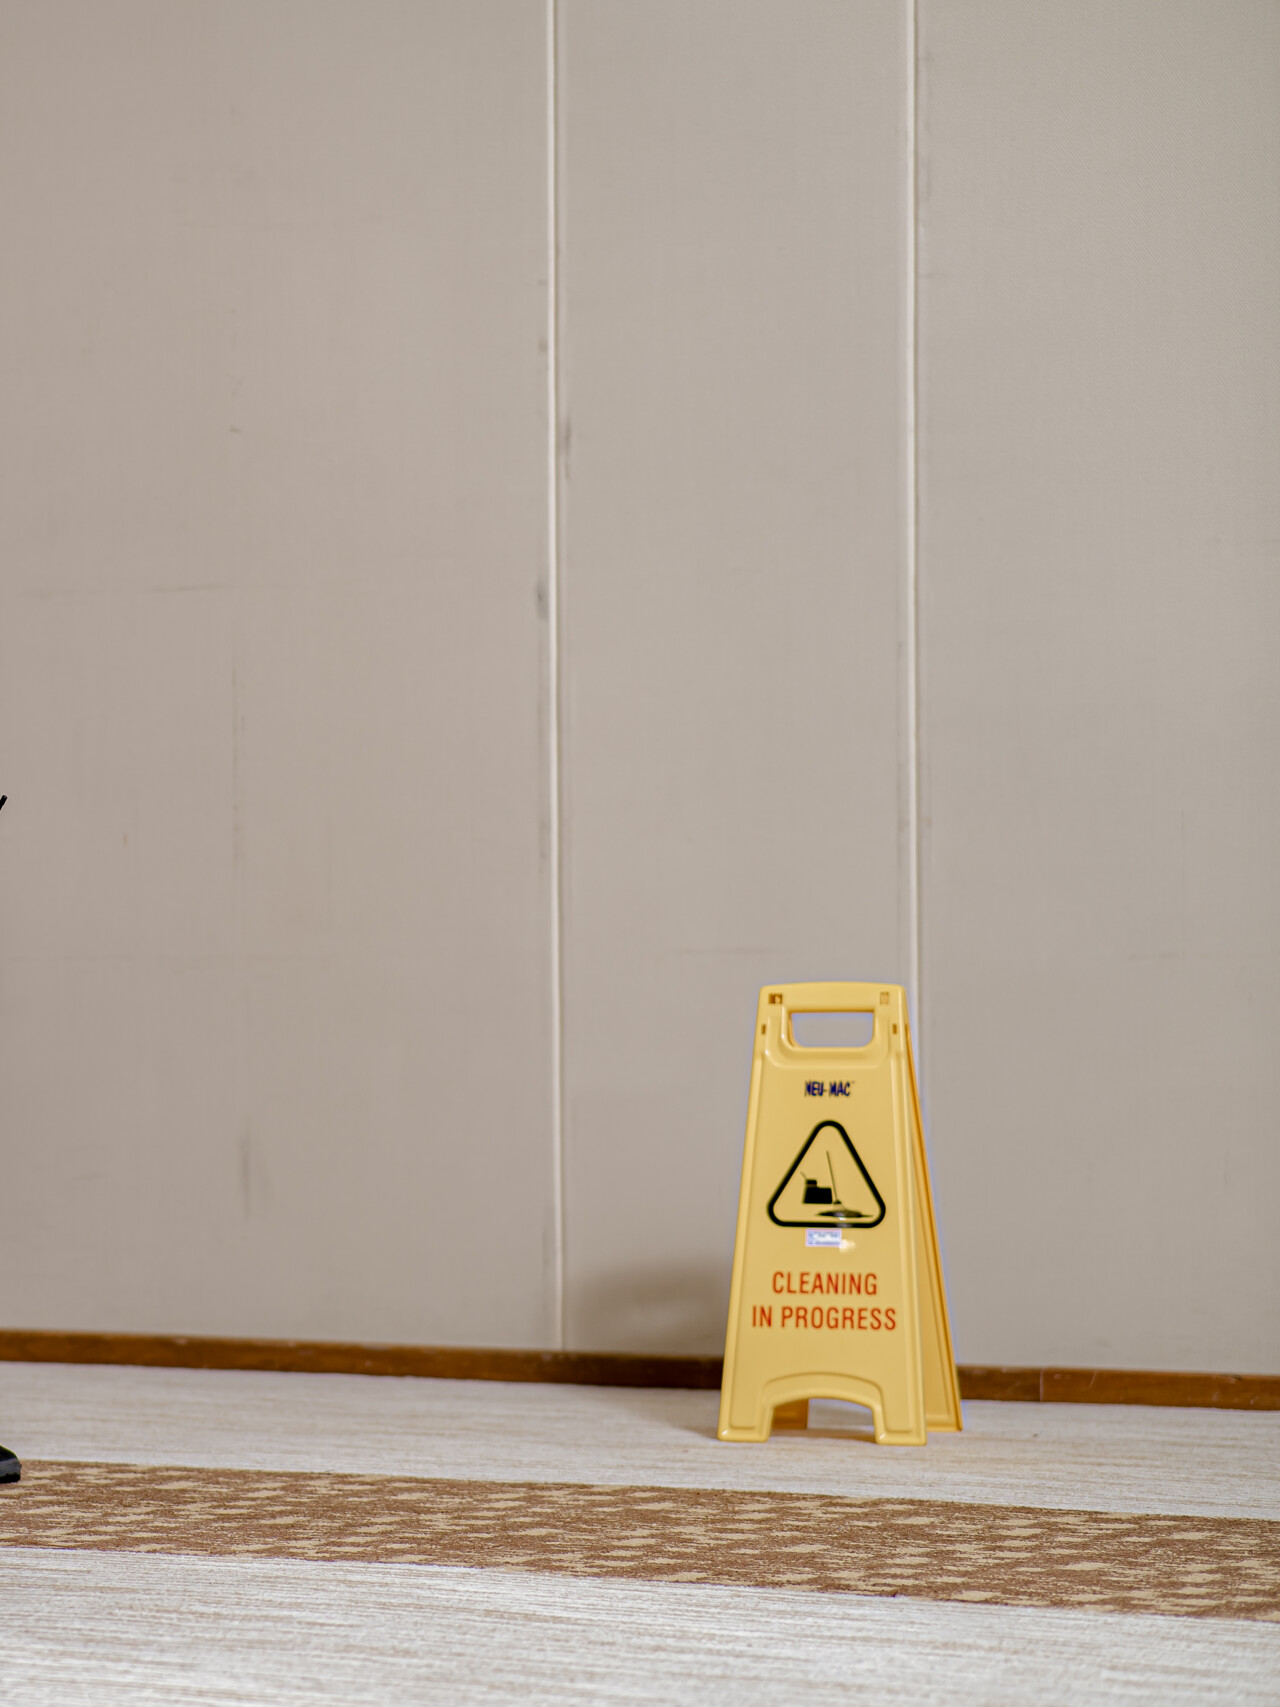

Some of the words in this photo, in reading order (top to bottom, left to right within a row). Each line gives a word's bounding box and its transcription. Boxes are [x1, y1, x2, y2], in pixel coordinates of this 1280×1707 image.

[772, 1271, 877, 1295] CLEANING
[752, 1305, 772, 1327] IN
[781, 1306, 896, 1330] PROGRESS
